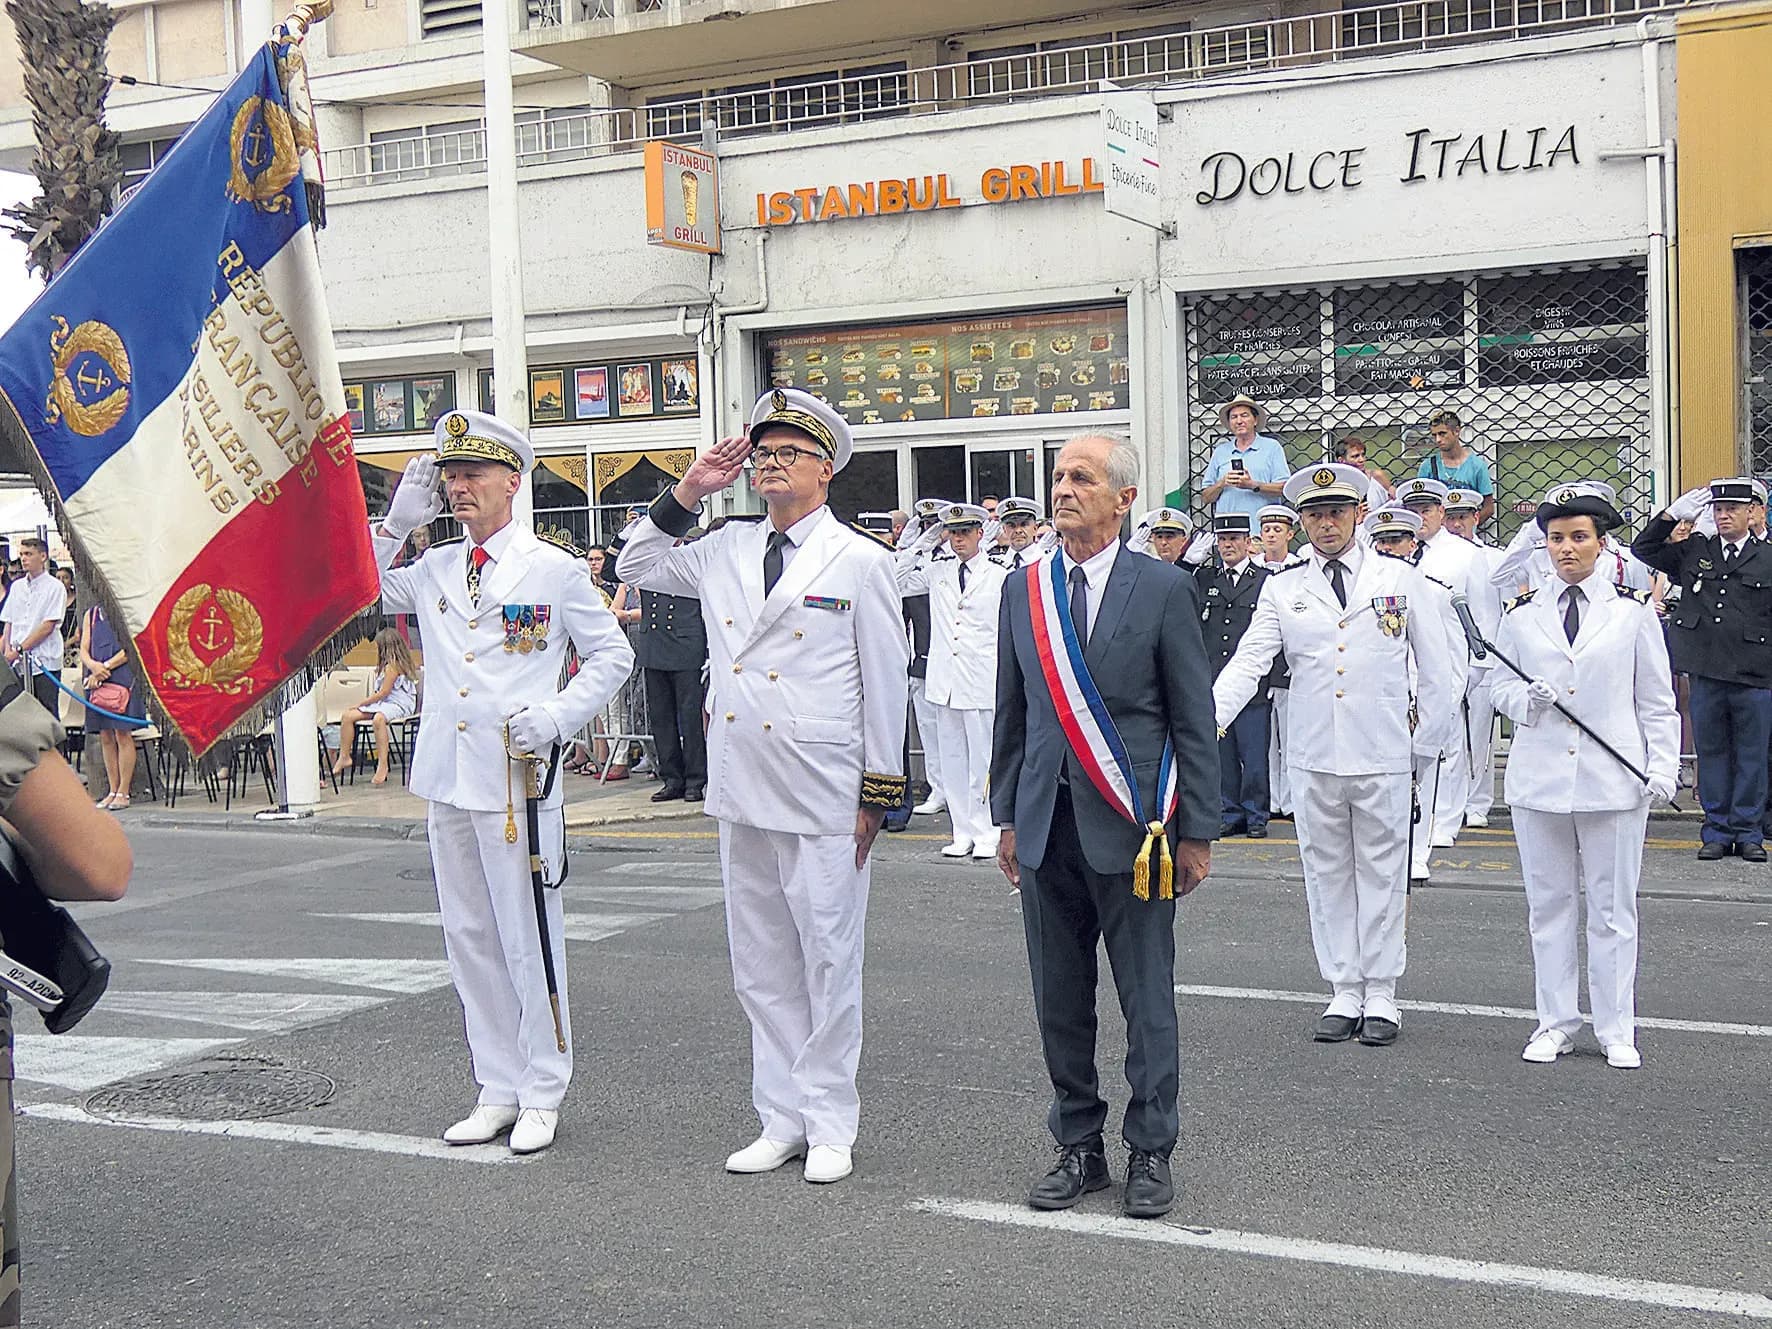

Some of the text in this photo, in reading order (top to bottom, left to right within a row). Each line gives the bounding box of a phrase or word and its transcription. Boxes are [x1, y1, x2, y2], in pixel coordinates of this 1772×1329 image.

[1107, 108, 1158, 148] DOLCE ITALIA
[664, 148, 712, 173] ISTANBUL
[1196, 125, 1580, 205] DOLCE ITALIA
[757, 158, 1104, 225] ISTANBUL GRILL
[674, 226, 707, 245] GRILL
[951, 322, 1012, 333] NOS ASSIETTES
[783, 335, 827, 345] SANDWICHS
[1530, 358, 1584, 371] ET CHAUDES
